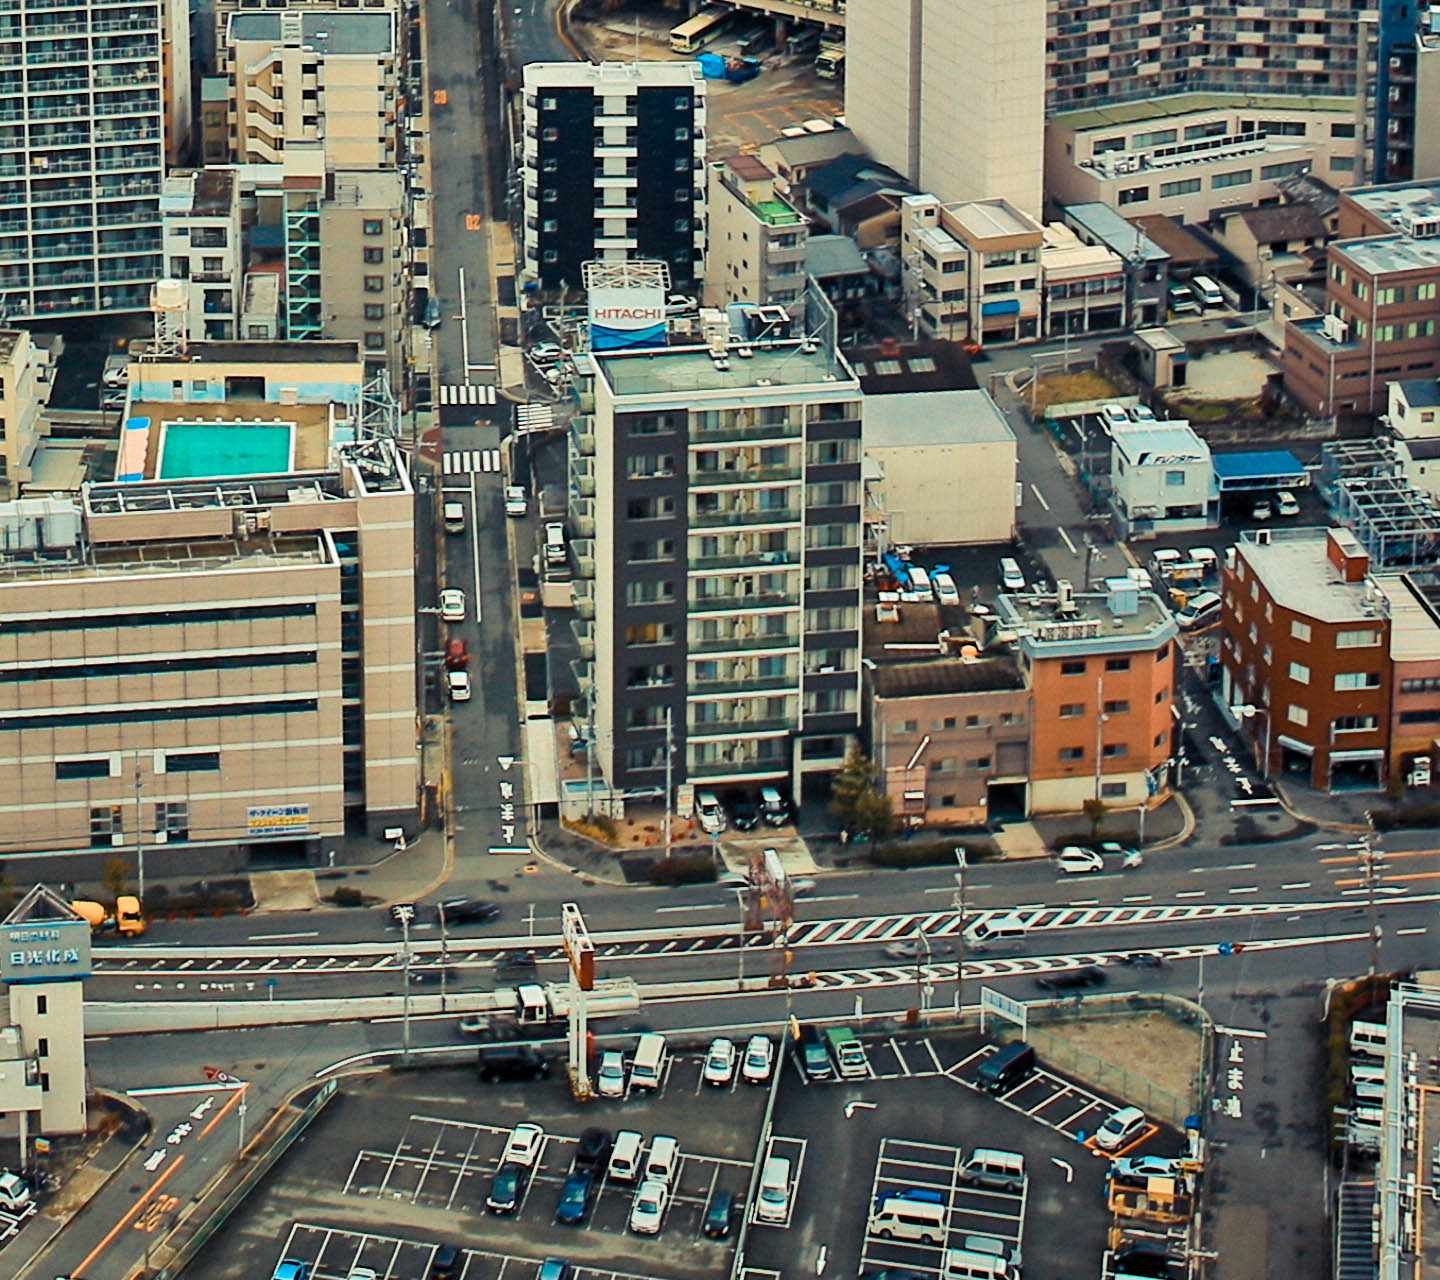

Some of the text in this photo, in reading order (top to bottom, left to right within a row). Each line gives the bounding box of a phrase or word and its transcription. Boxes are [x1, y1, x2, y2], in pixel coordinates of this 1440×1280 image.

[594, 308, 661, 319] HITACHI
[10, 948, 80, 964] 日光化成
